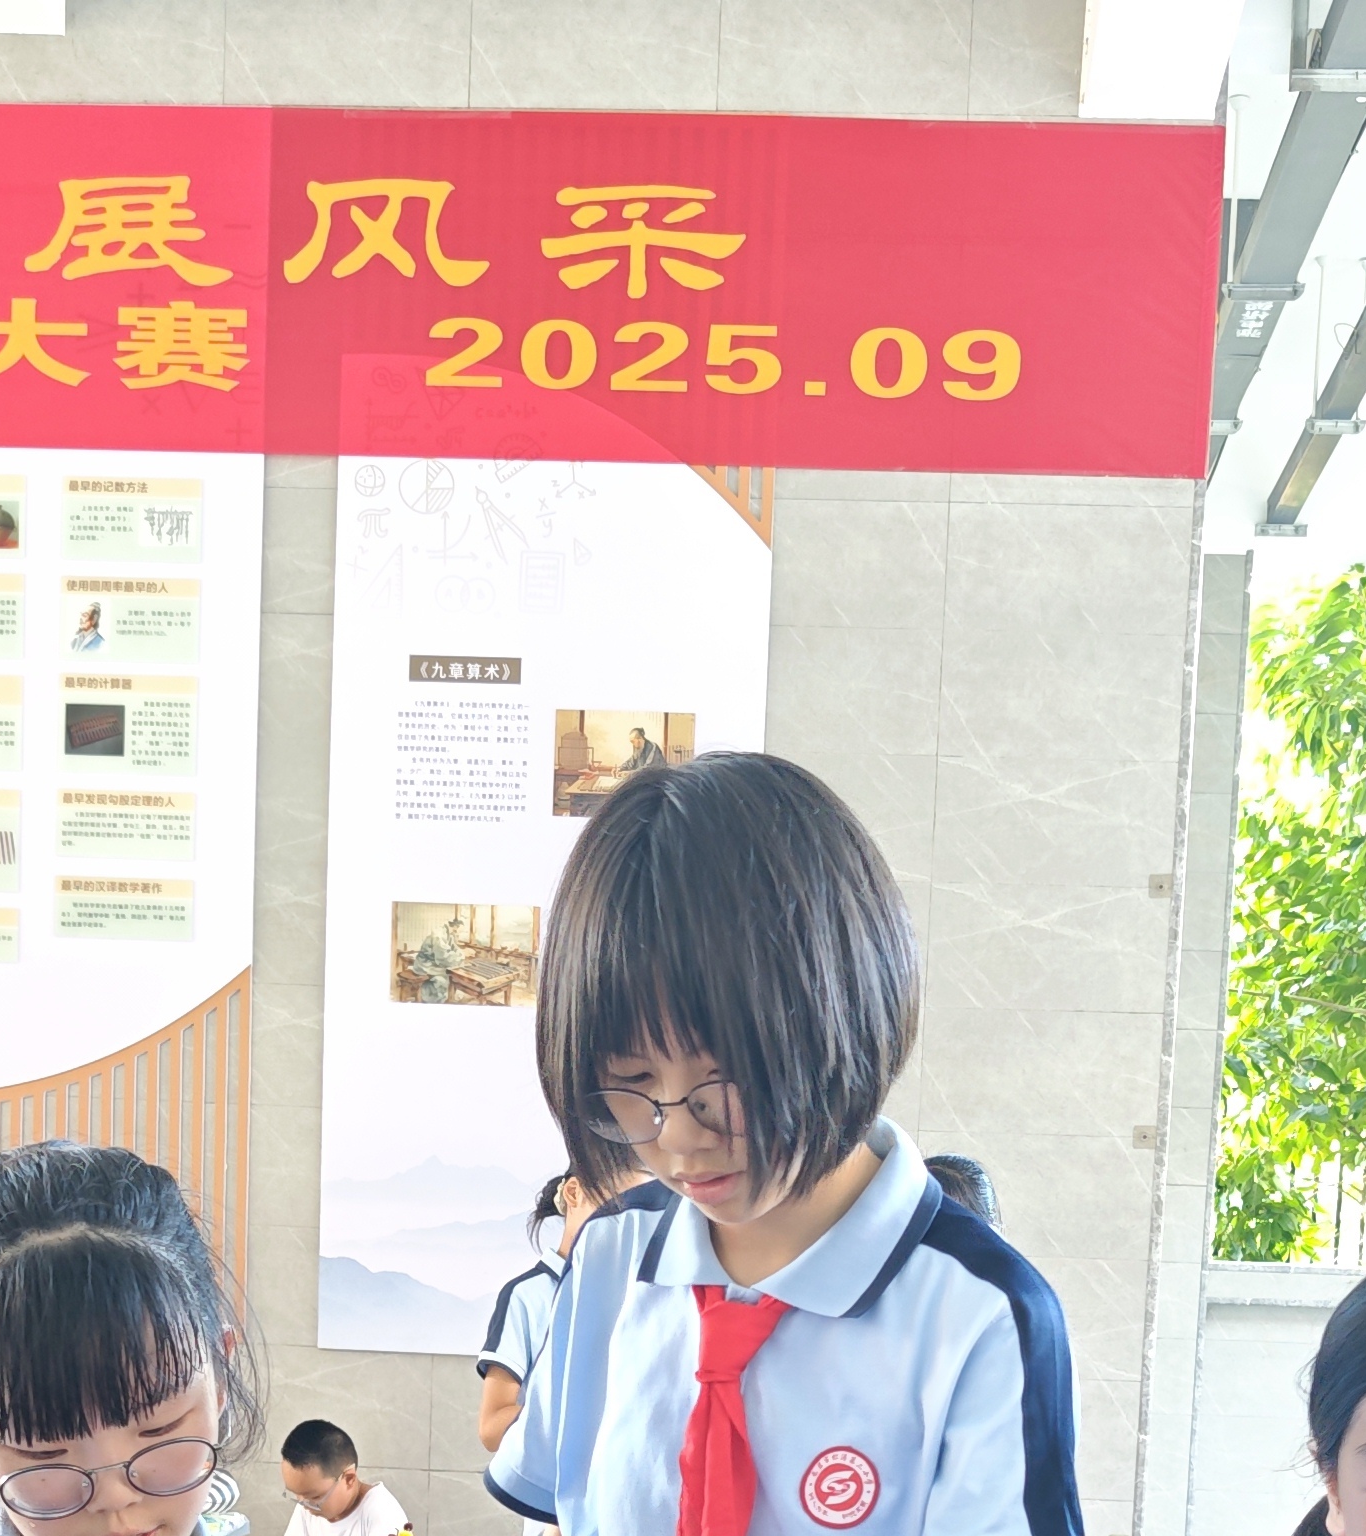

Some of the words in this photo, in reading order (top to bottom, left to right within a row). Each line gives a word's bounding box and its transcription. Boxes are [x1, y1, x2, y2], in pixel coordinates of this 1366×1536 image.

[425, 317, 1023, 402] 2025.09
[67, 479, 149, 494] 最早的记数方法
[66, 579, 168, 595] 使用圆周率最早的人
[418, 660, 512, 681] 《九章算术》
[61, 792, 176, 808] 最早发现勾股定理的人
[60, 879, 163, 895] 最早的汉译数学著作
